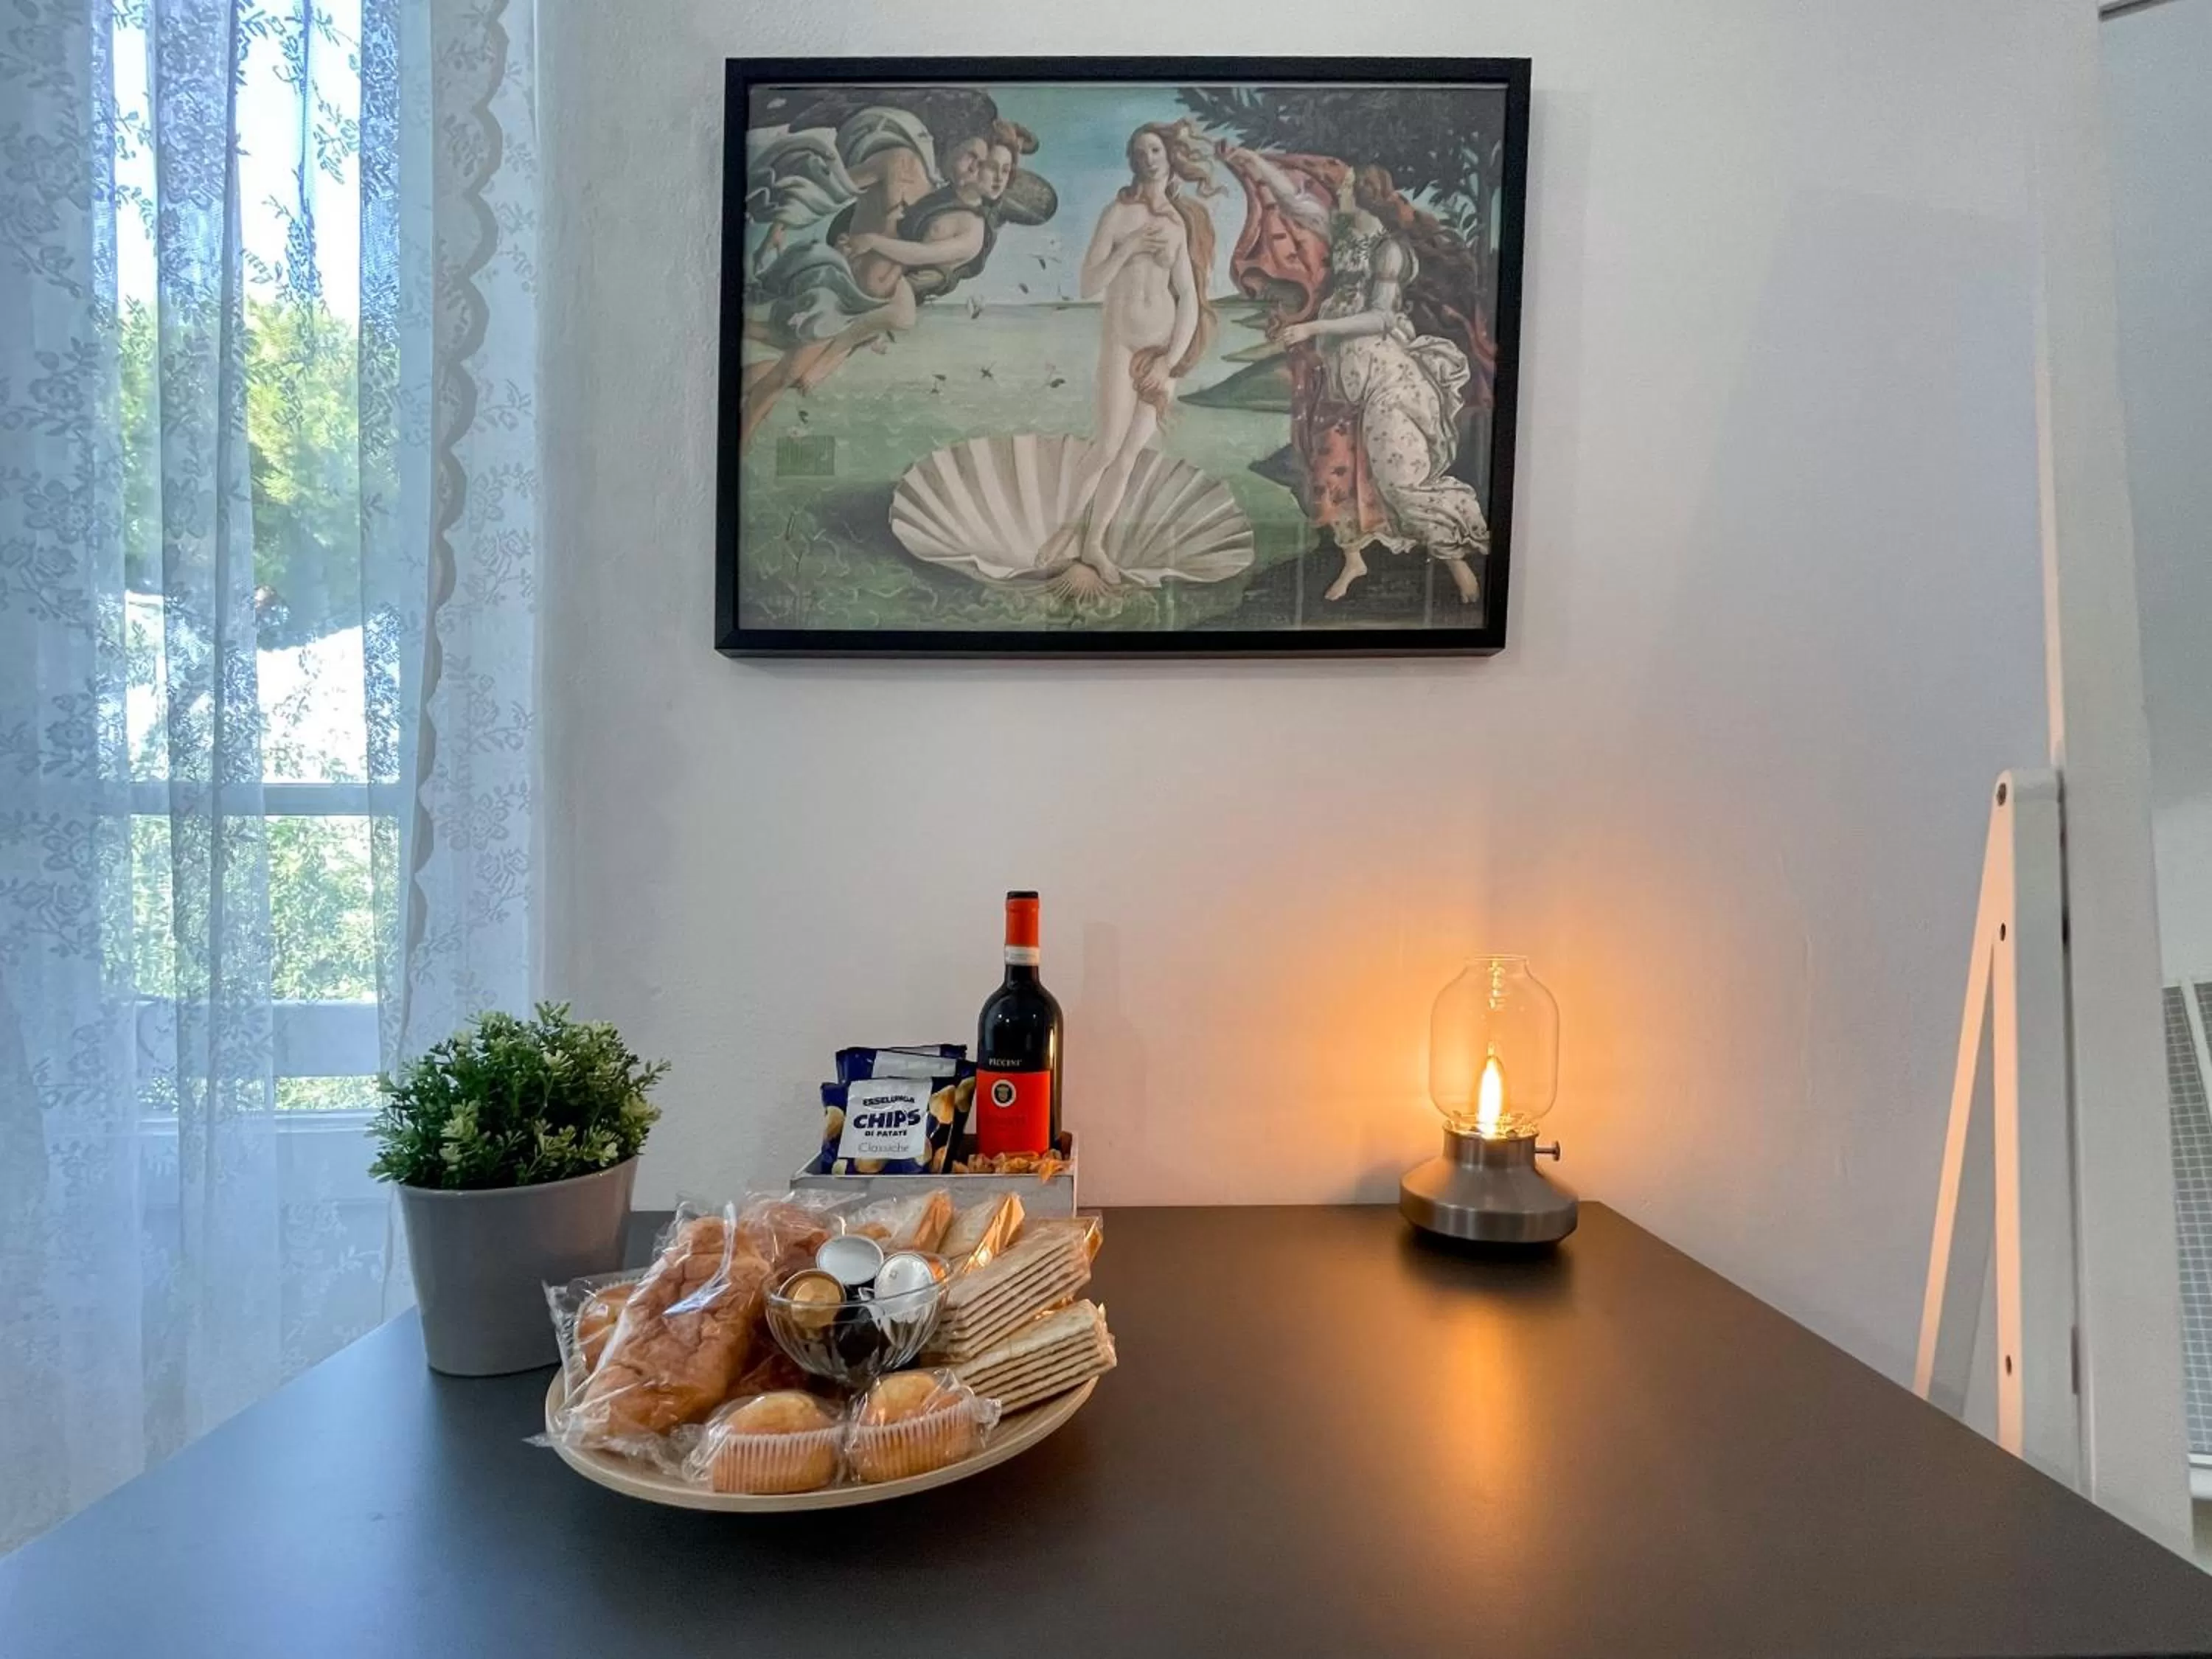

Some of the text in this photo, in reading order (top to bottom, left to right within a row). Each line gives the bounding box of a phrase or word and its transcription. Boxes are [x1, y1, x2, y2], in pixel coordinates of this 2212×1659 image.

[863, 1095, 915, 1106] ESSELUNGA
[853, 1108, 921, 1129] CHIPS
[858, 1143, 909, 1152] Classiche
